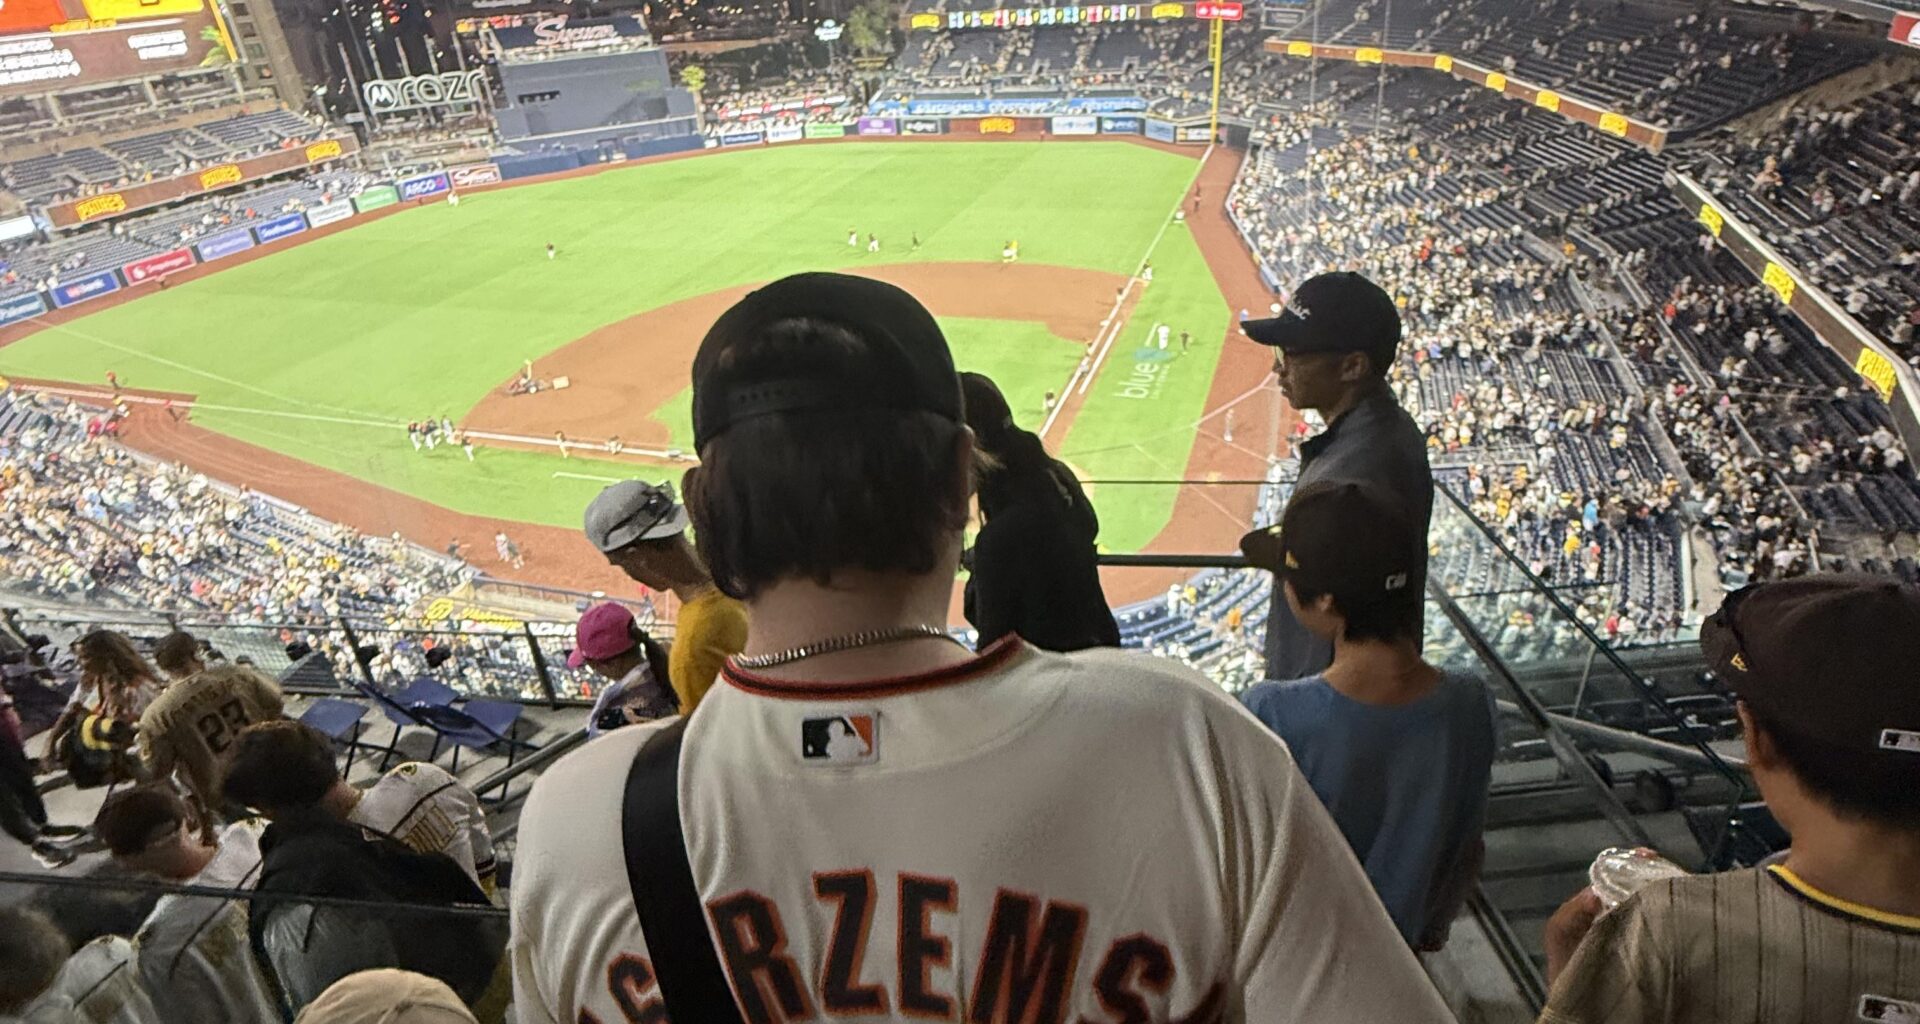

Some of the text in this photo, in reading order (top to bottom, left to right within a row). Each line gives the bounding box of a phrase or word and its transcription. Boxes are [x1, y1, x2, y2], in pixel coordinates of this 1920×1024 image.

[405, 179, 436, 196] ARCO
[1112, 363, 1159, 399] blue
[197, 698, 249, 754] 23
